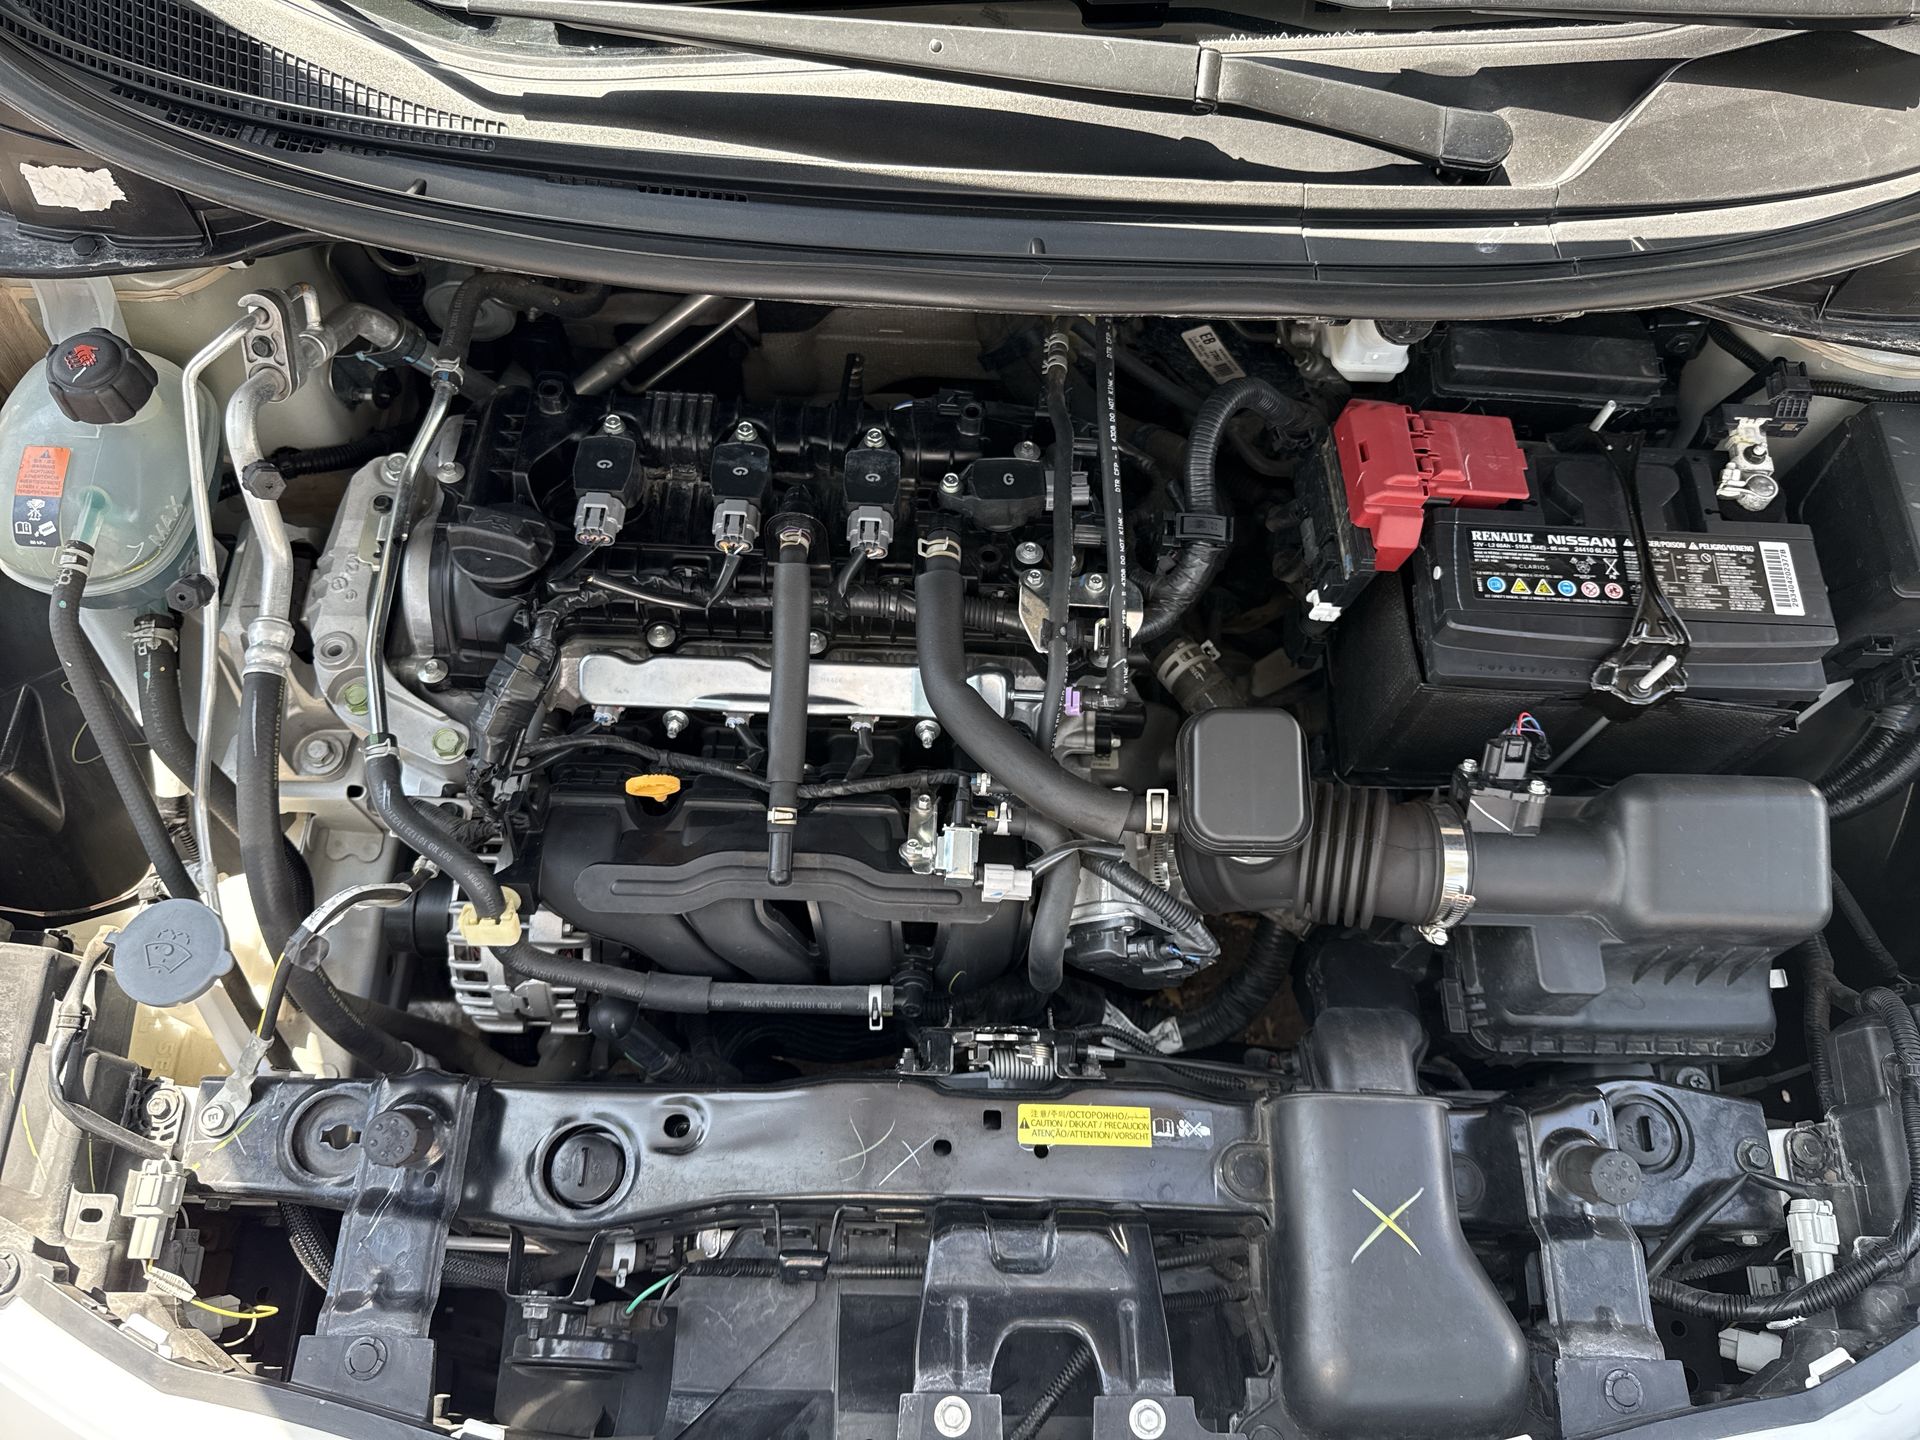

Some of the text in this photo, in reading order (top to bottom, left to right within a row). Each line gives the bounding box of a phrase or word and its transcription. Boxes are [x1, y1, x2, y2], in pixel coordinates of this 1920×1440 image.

[1199, 332, 1216, 344] EB
[1109, 413, 1116, 422] DO
[596, 460, 614, 469] G
[732, 466, 749, 476] G
[865, 473, 881, 482] G
[1003, 472, 1015, 486] G
[148, 495, 184, 546] MAX
[1471, 530, 1616, 548] RENAULT NISSAN
[1698, 543, 1754, 552] PELIGRO/VENENO
[1120, 555, 1126, 565] DO
